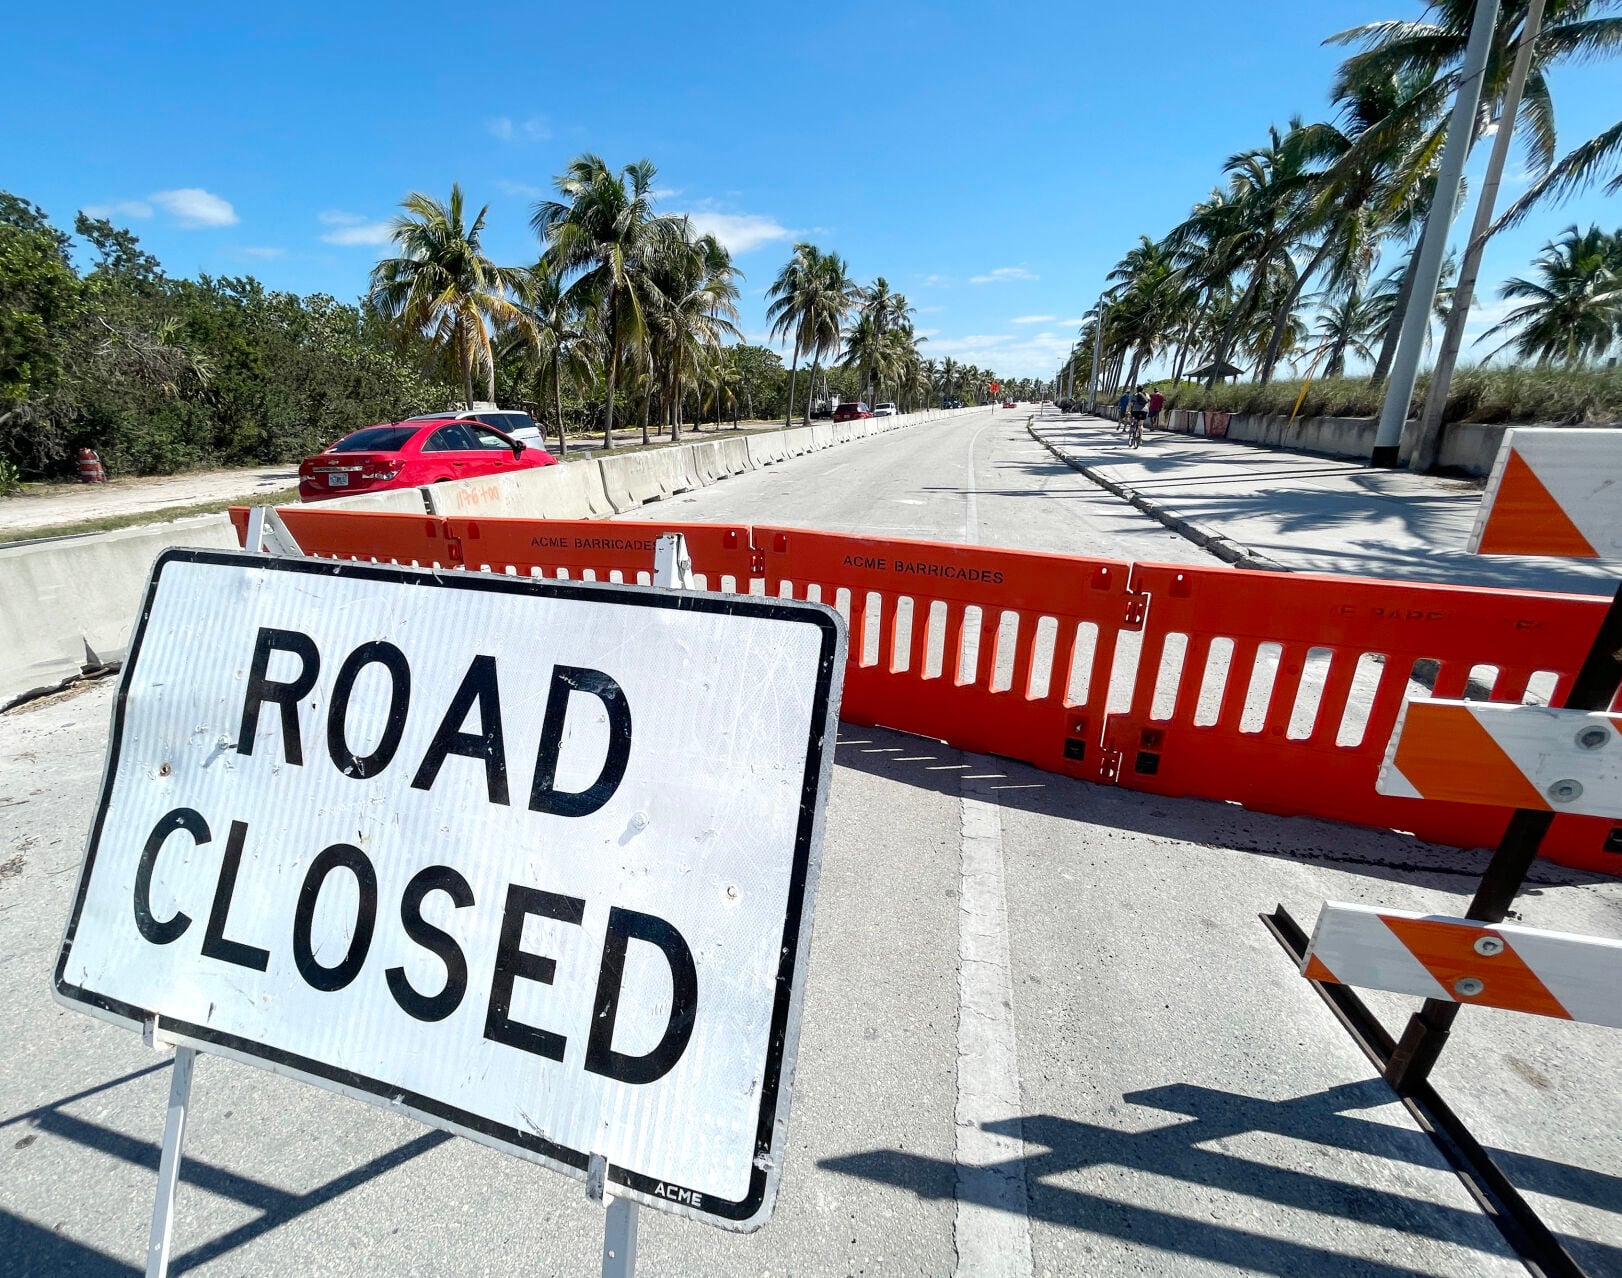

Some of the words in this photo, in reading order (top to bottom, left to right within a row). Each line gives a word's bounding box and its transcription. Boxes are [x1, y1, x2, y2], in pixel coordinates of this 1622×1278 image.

[531, 536, 568, 548] ACME
[843, 555, 886, 571] ACME
[894, 560, 1004, 584] BARRICADES
[236, 626, 632, 818] ROAD
[133, 807, 698, 1085] CLOSED
[654, 1182, 703, 1207] ACME
